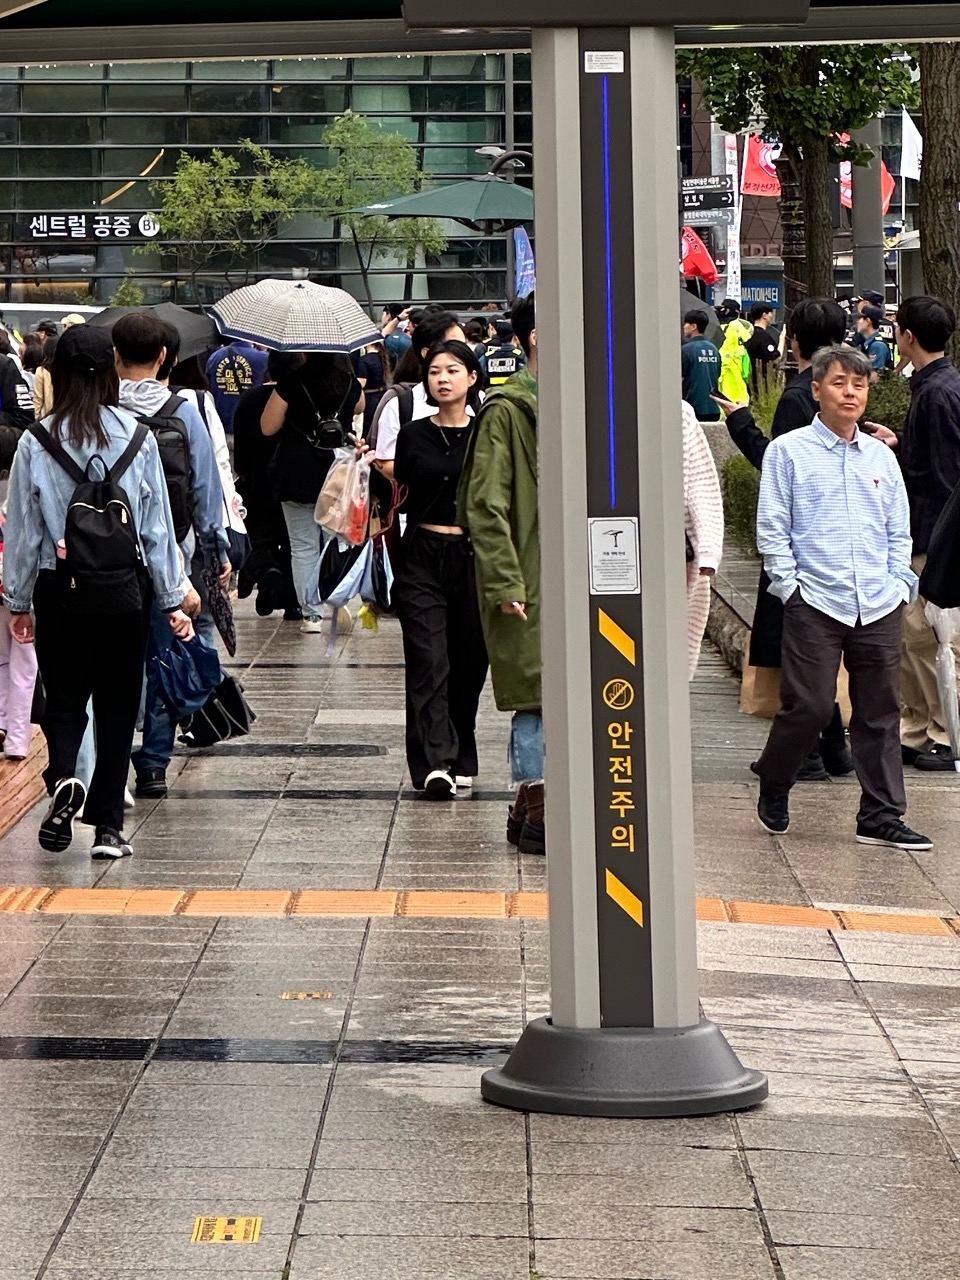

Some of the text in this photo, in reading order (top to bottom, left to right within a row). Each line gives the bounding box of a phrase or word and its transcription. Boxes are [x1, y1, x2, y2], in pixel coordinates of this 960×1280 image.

[29, 214, 87, 238] 센트럴
[92, 215, 132, 238] 공증
[216, 357, 230, 377] PARTS
[607, 721, 636, 853] 안전주의
